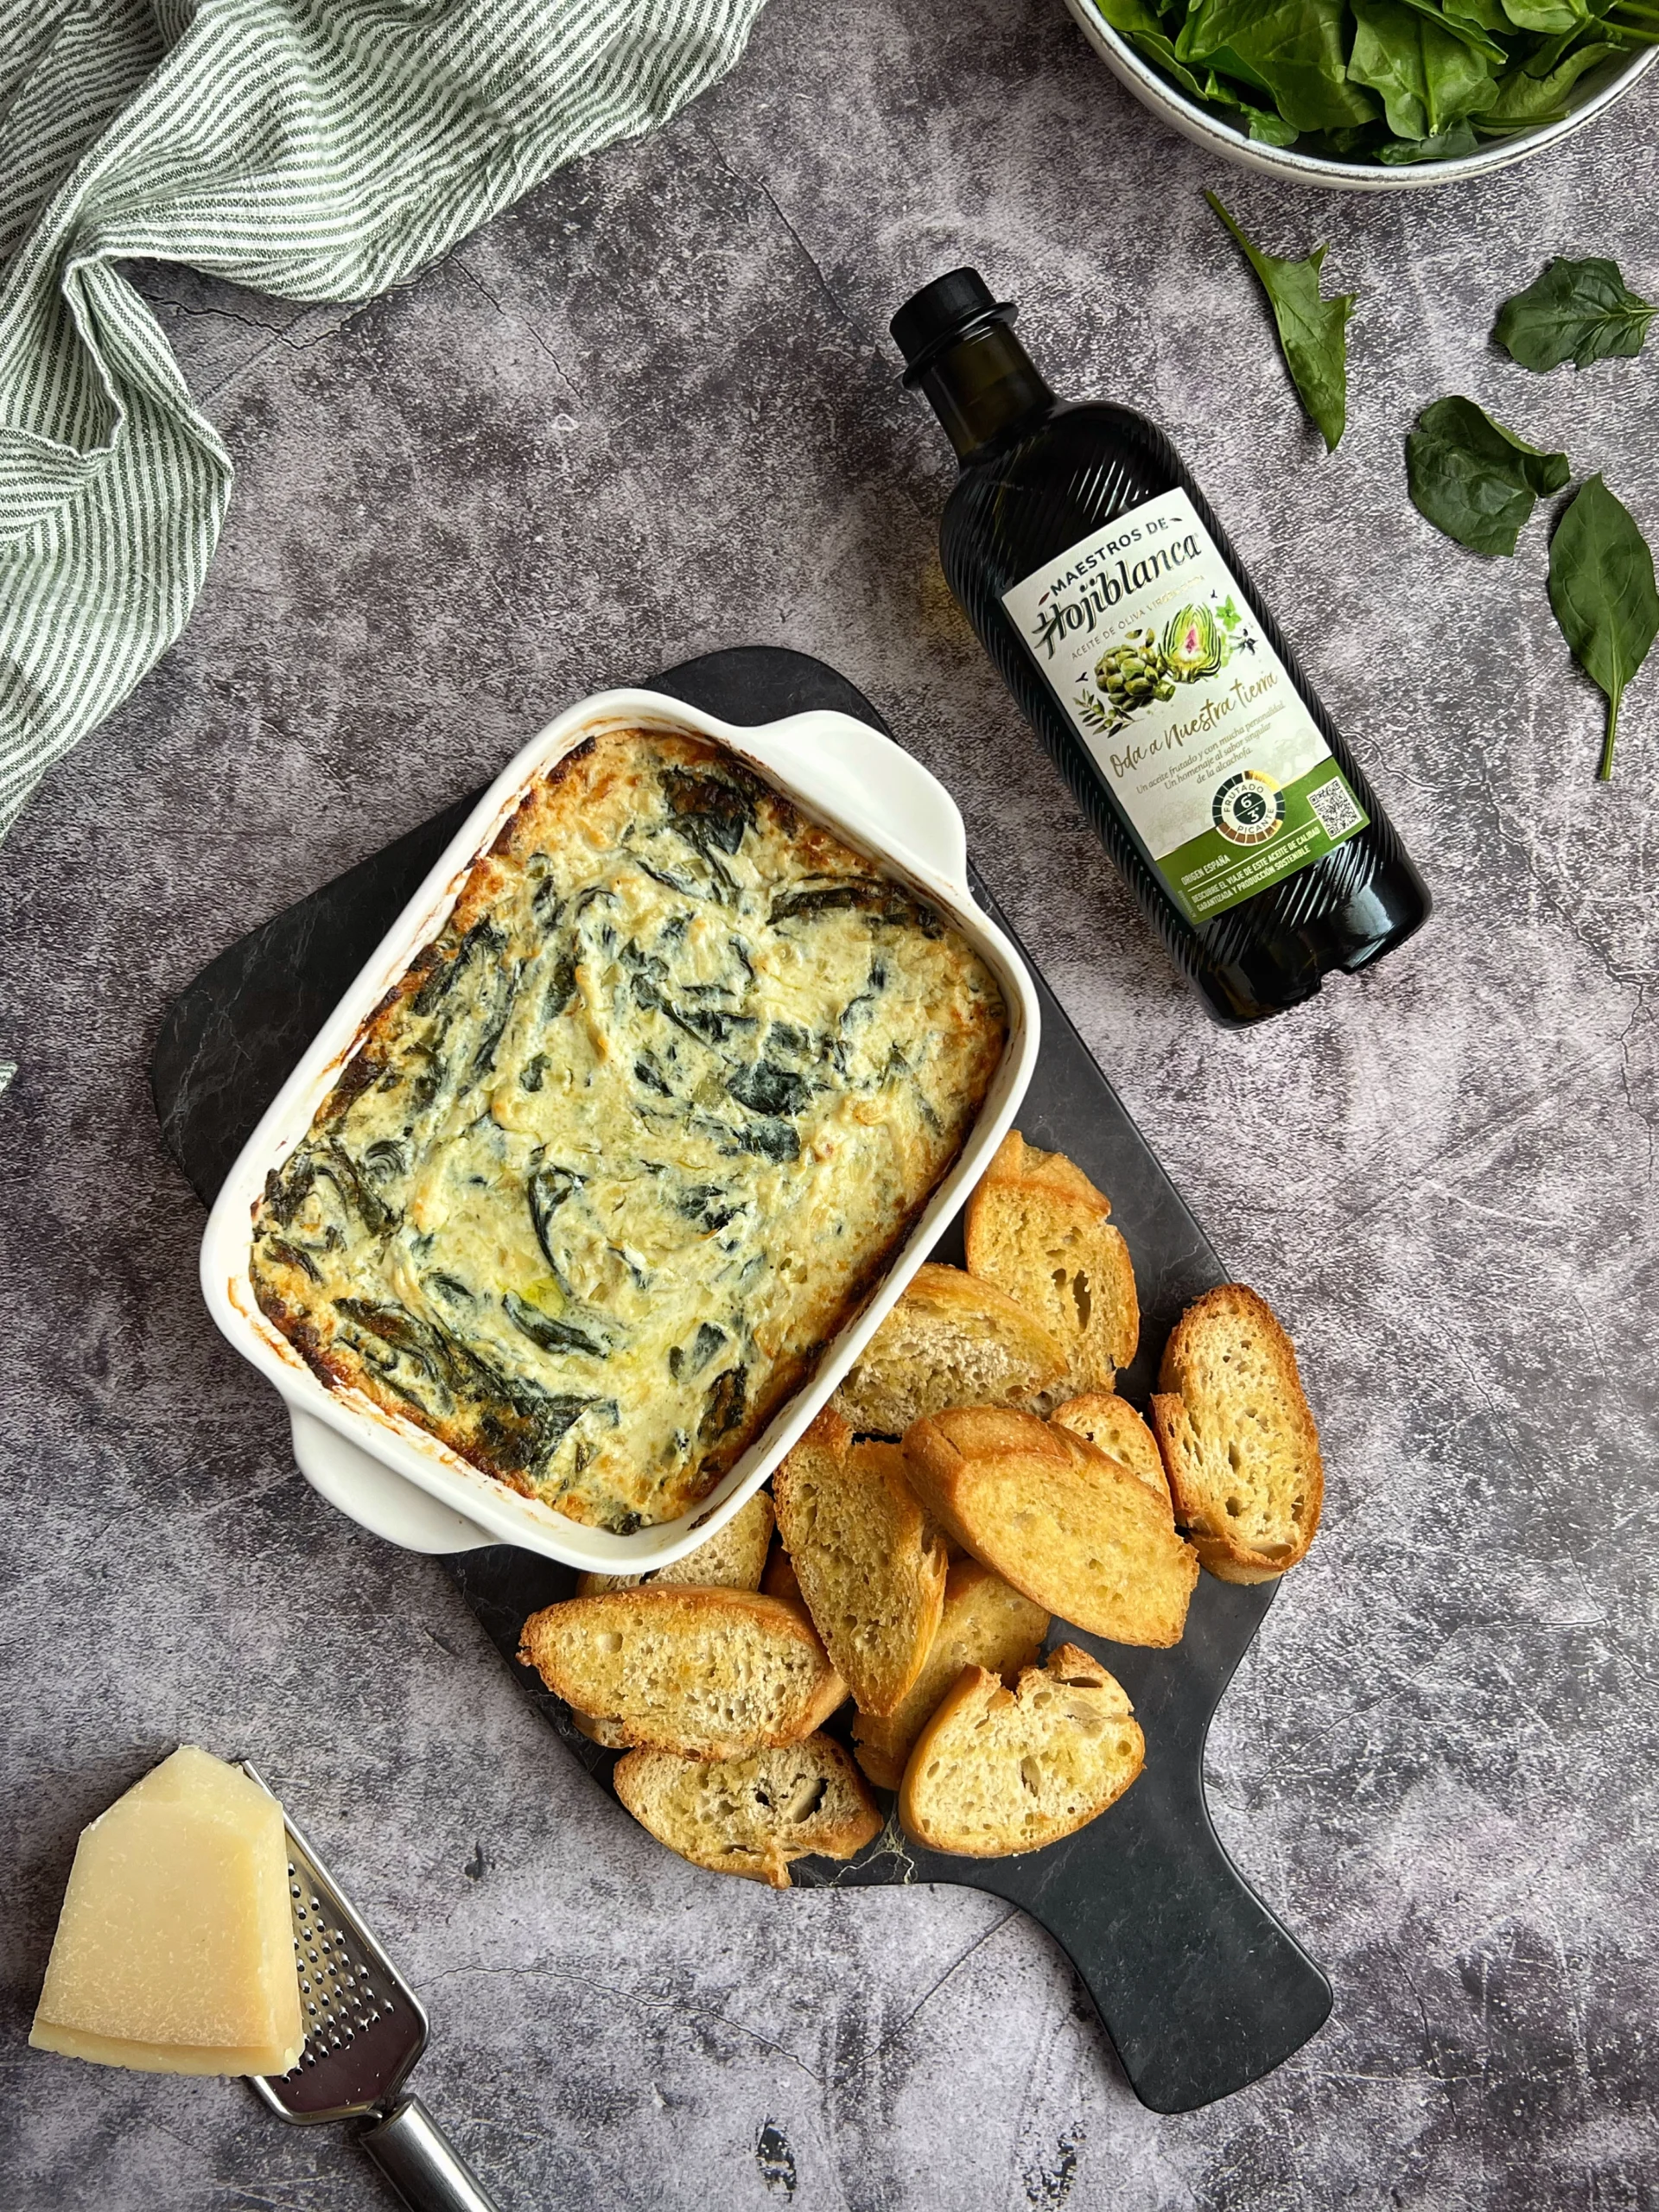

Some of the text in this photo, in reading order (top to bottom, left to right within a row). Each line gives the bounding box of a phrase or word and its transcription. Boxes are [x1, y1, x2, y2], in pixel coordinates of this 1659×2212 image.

[1050, 528, 1142, 596] MAESTROS
[1146, 518, 1168, 535] DE
[1032, 534, 1202, 660] Hojiblanca
[1071, 637, 1100, 660] ACEITE
[1103, 627, 1116, 640] DE
[1118, 608, 1146, 629] OLIVA
[1109, 745, 1147, 779] Oda
[1149, 739, 1165, 753] a
[1135, 784, 1148, 795] Un
[1148, 772, 1169, 789] aceite
[1168, 755, 1198, 778] frutado
[1198, 752, 1205, 762] y
[1205, 742, 1219, 756] con
[1219, 728, 1245, 745] mucha
[1164, 723, 1271, 791] Un homenaje al sabor singular
[1196, 749, 1252, 785] de la alcachofa.
[1224, 784, 1264, 813] FRUTADO
[1236, 808, 1274, 834] PICANTE
[1180, 854, 1231, 886] ORIGEN ESPAÑA
[1191, 882, 1219, 904] DESCUBRE
[1219, 880, 1228, 889] EL
[1225, 871, 1244, 886] VIAJE
[1244, 867, 1254, 875] DE
[1252, 857, 1269, 872] ESTE
[1268, 849, 1288, 863] ACEITE
[1287, 841, 1297, 853] DE
[1296, 826, 1321, 847] CALIDAD
[1197, 890, 1233, 912] GARANTIZADA
[1231, 887, 1238, 895] Y
[1237, 867, 1276, 893] PRODUCCIÓN
[1275, 844, 1312, 871] SOSTENIBLE
